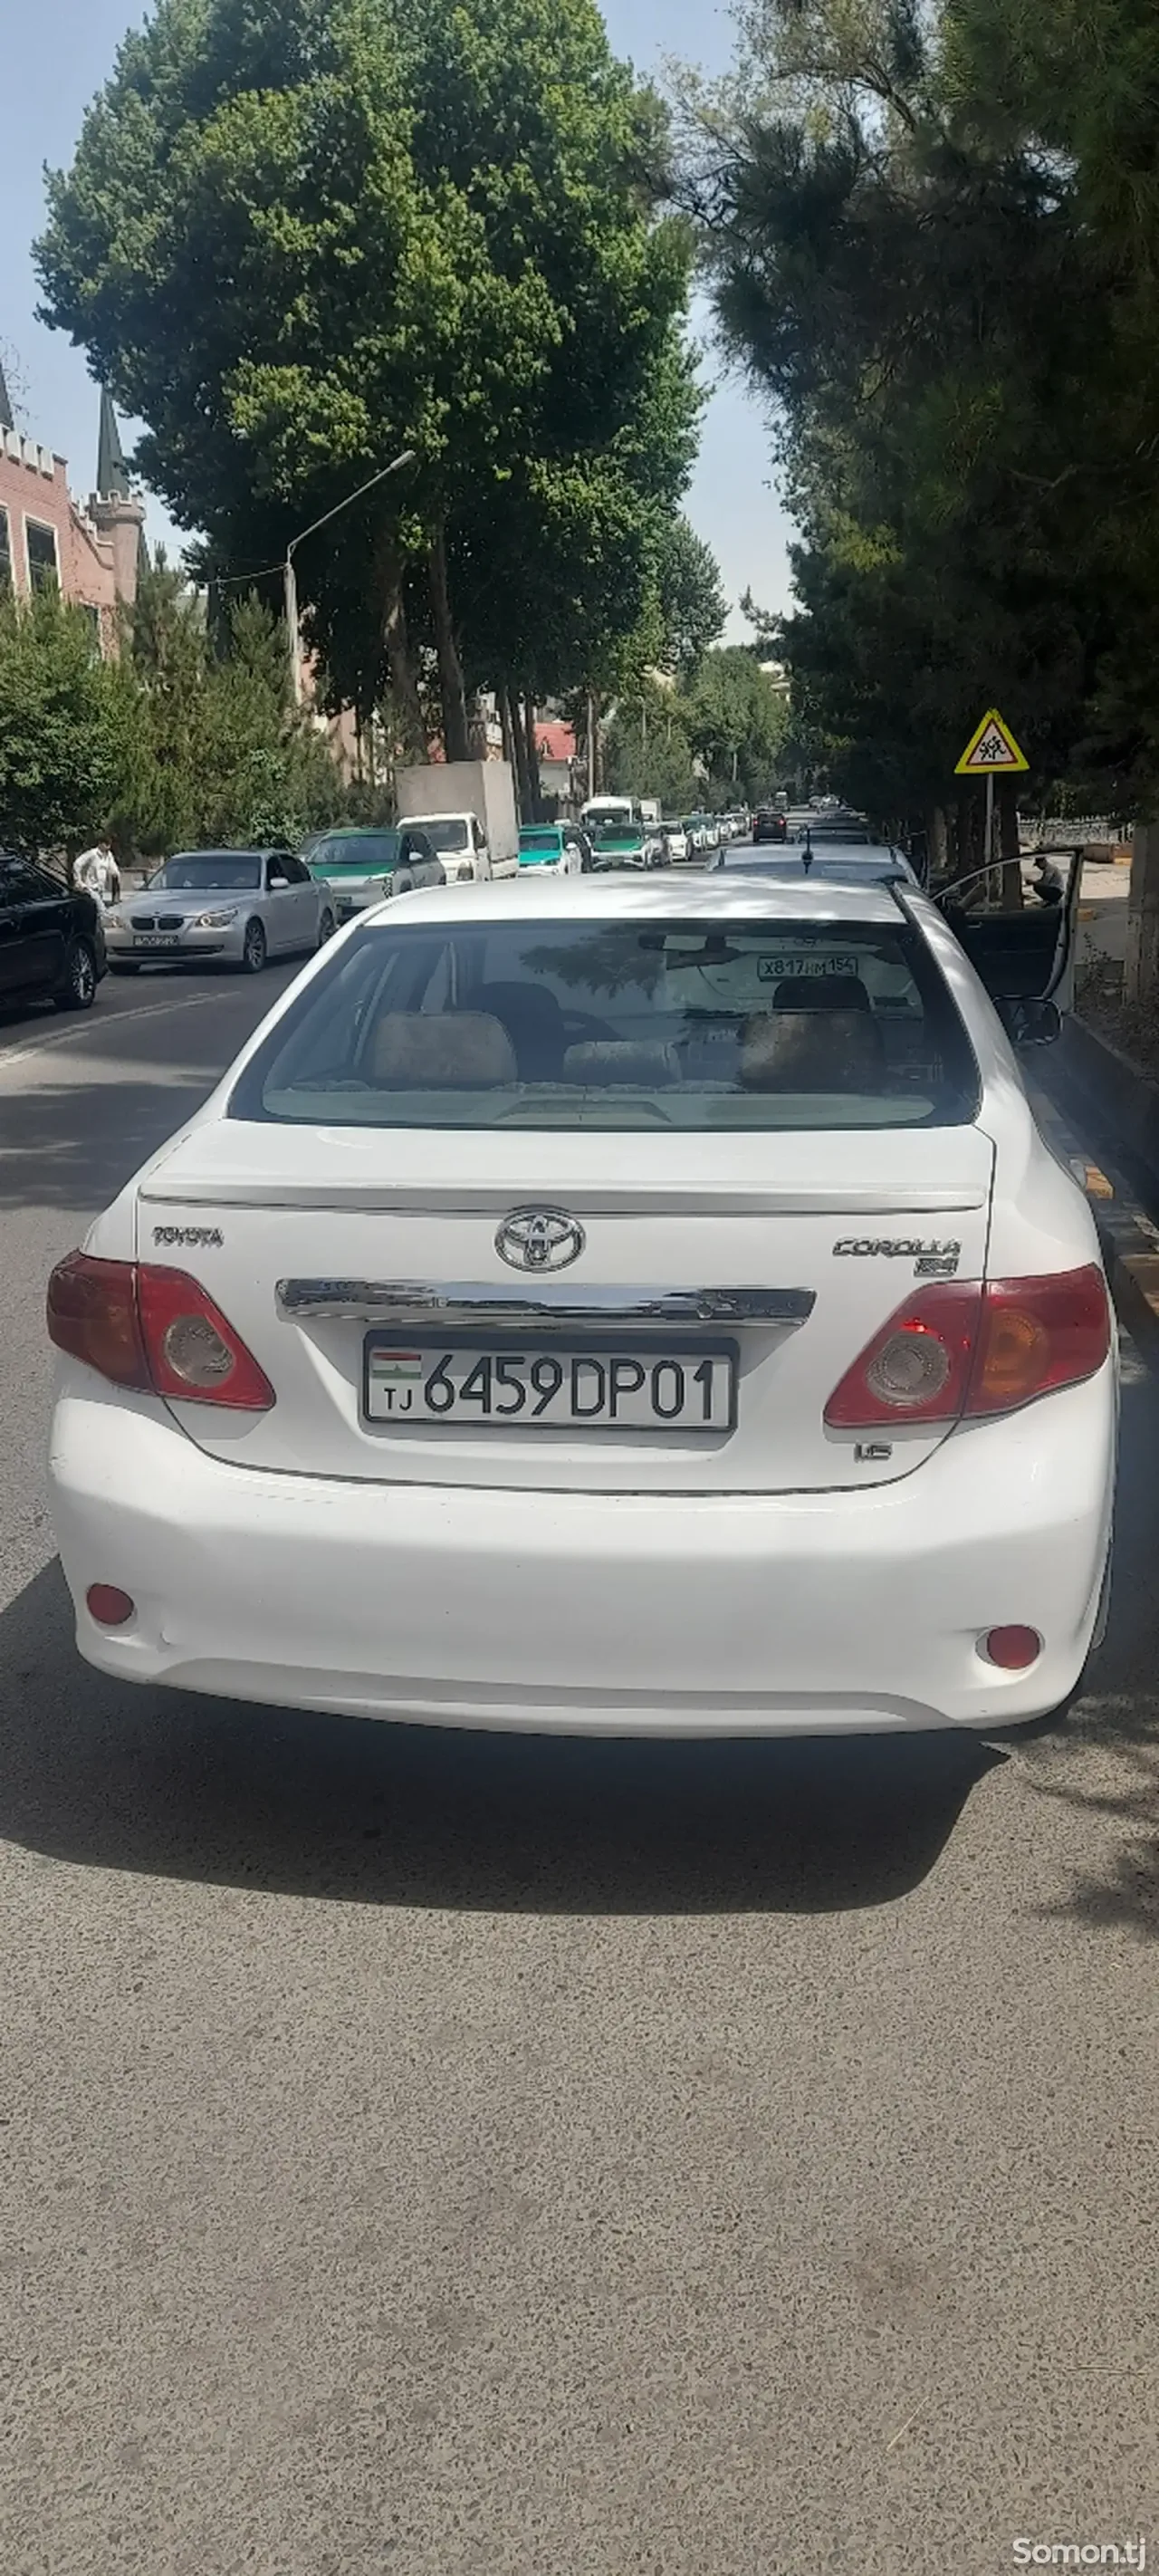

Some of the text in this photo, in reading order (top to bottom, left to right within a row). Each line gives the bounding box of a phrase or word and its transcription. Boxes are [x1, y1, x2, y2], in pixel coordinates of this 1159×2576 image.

[151, 1226, 225, 1248] TOYOTA
[832, 1238, 962, 1258] COROLLA
[384, 1354, 714, 1420] TJ 6459DP01
